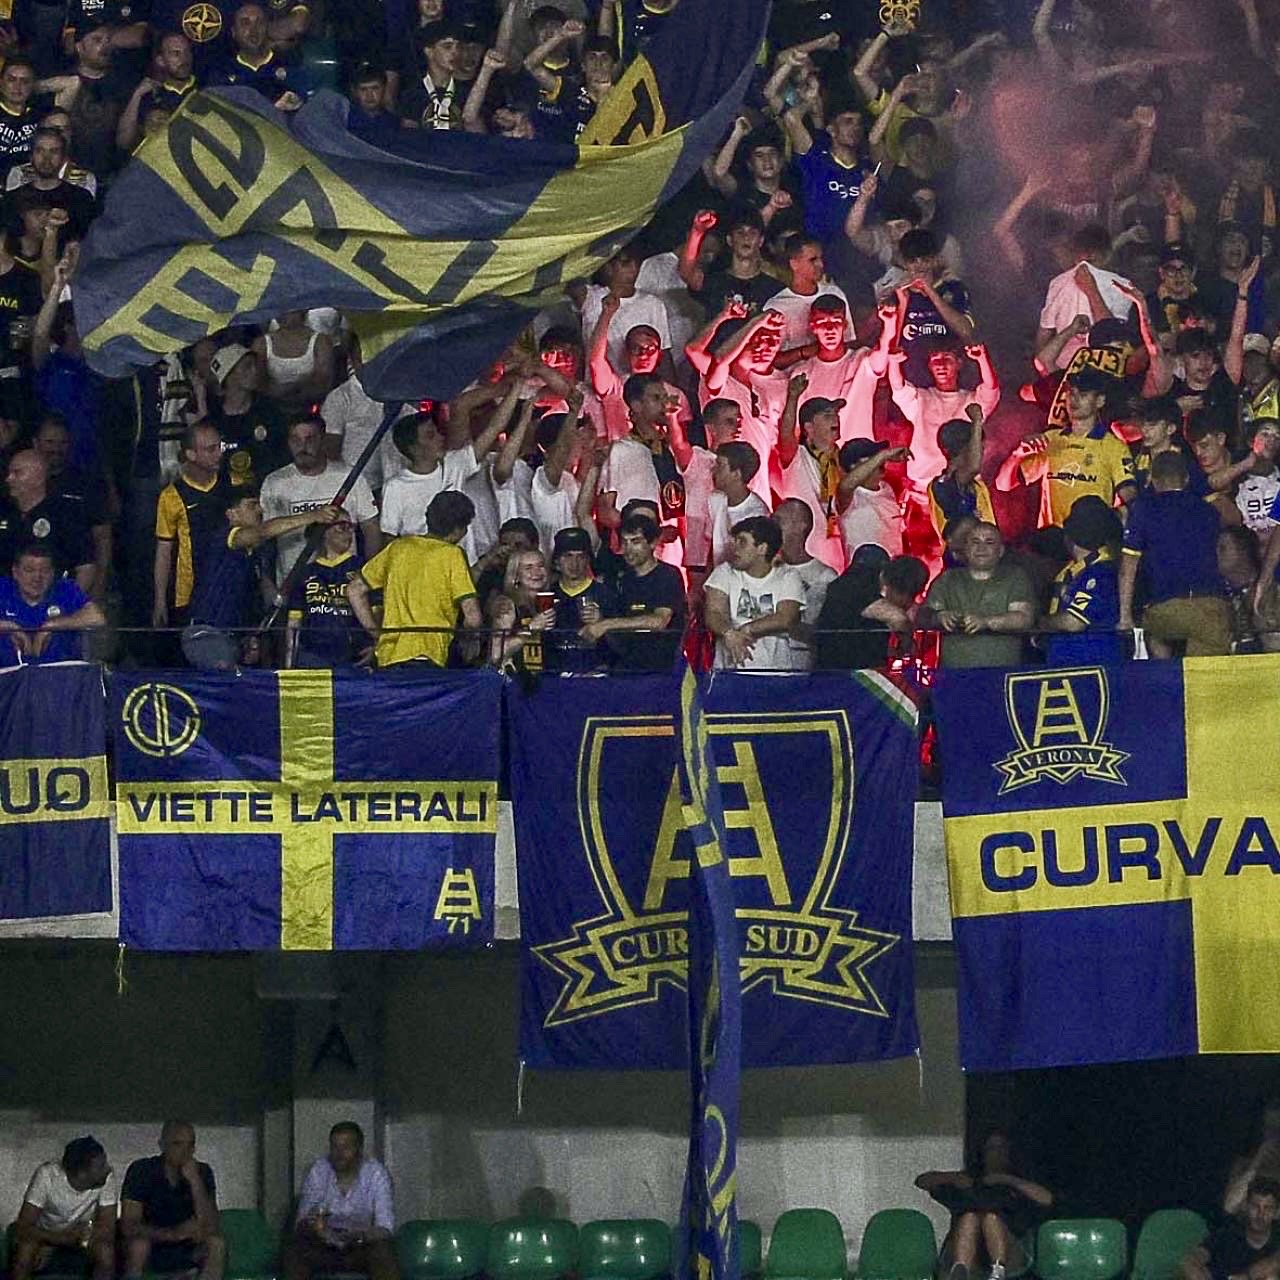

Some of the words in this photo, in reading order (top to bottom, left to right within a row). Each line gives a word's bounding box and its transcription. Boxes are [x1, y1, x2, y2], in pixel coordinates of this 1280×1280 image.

[1022, 749, 1098, 775] VERONA
[128, 792, 272, 823] VIETTE
[291, 791, 488, 822] LATERALI
[446, 915, 468, 934] 71
[746, 924, 818, 956] SUD
